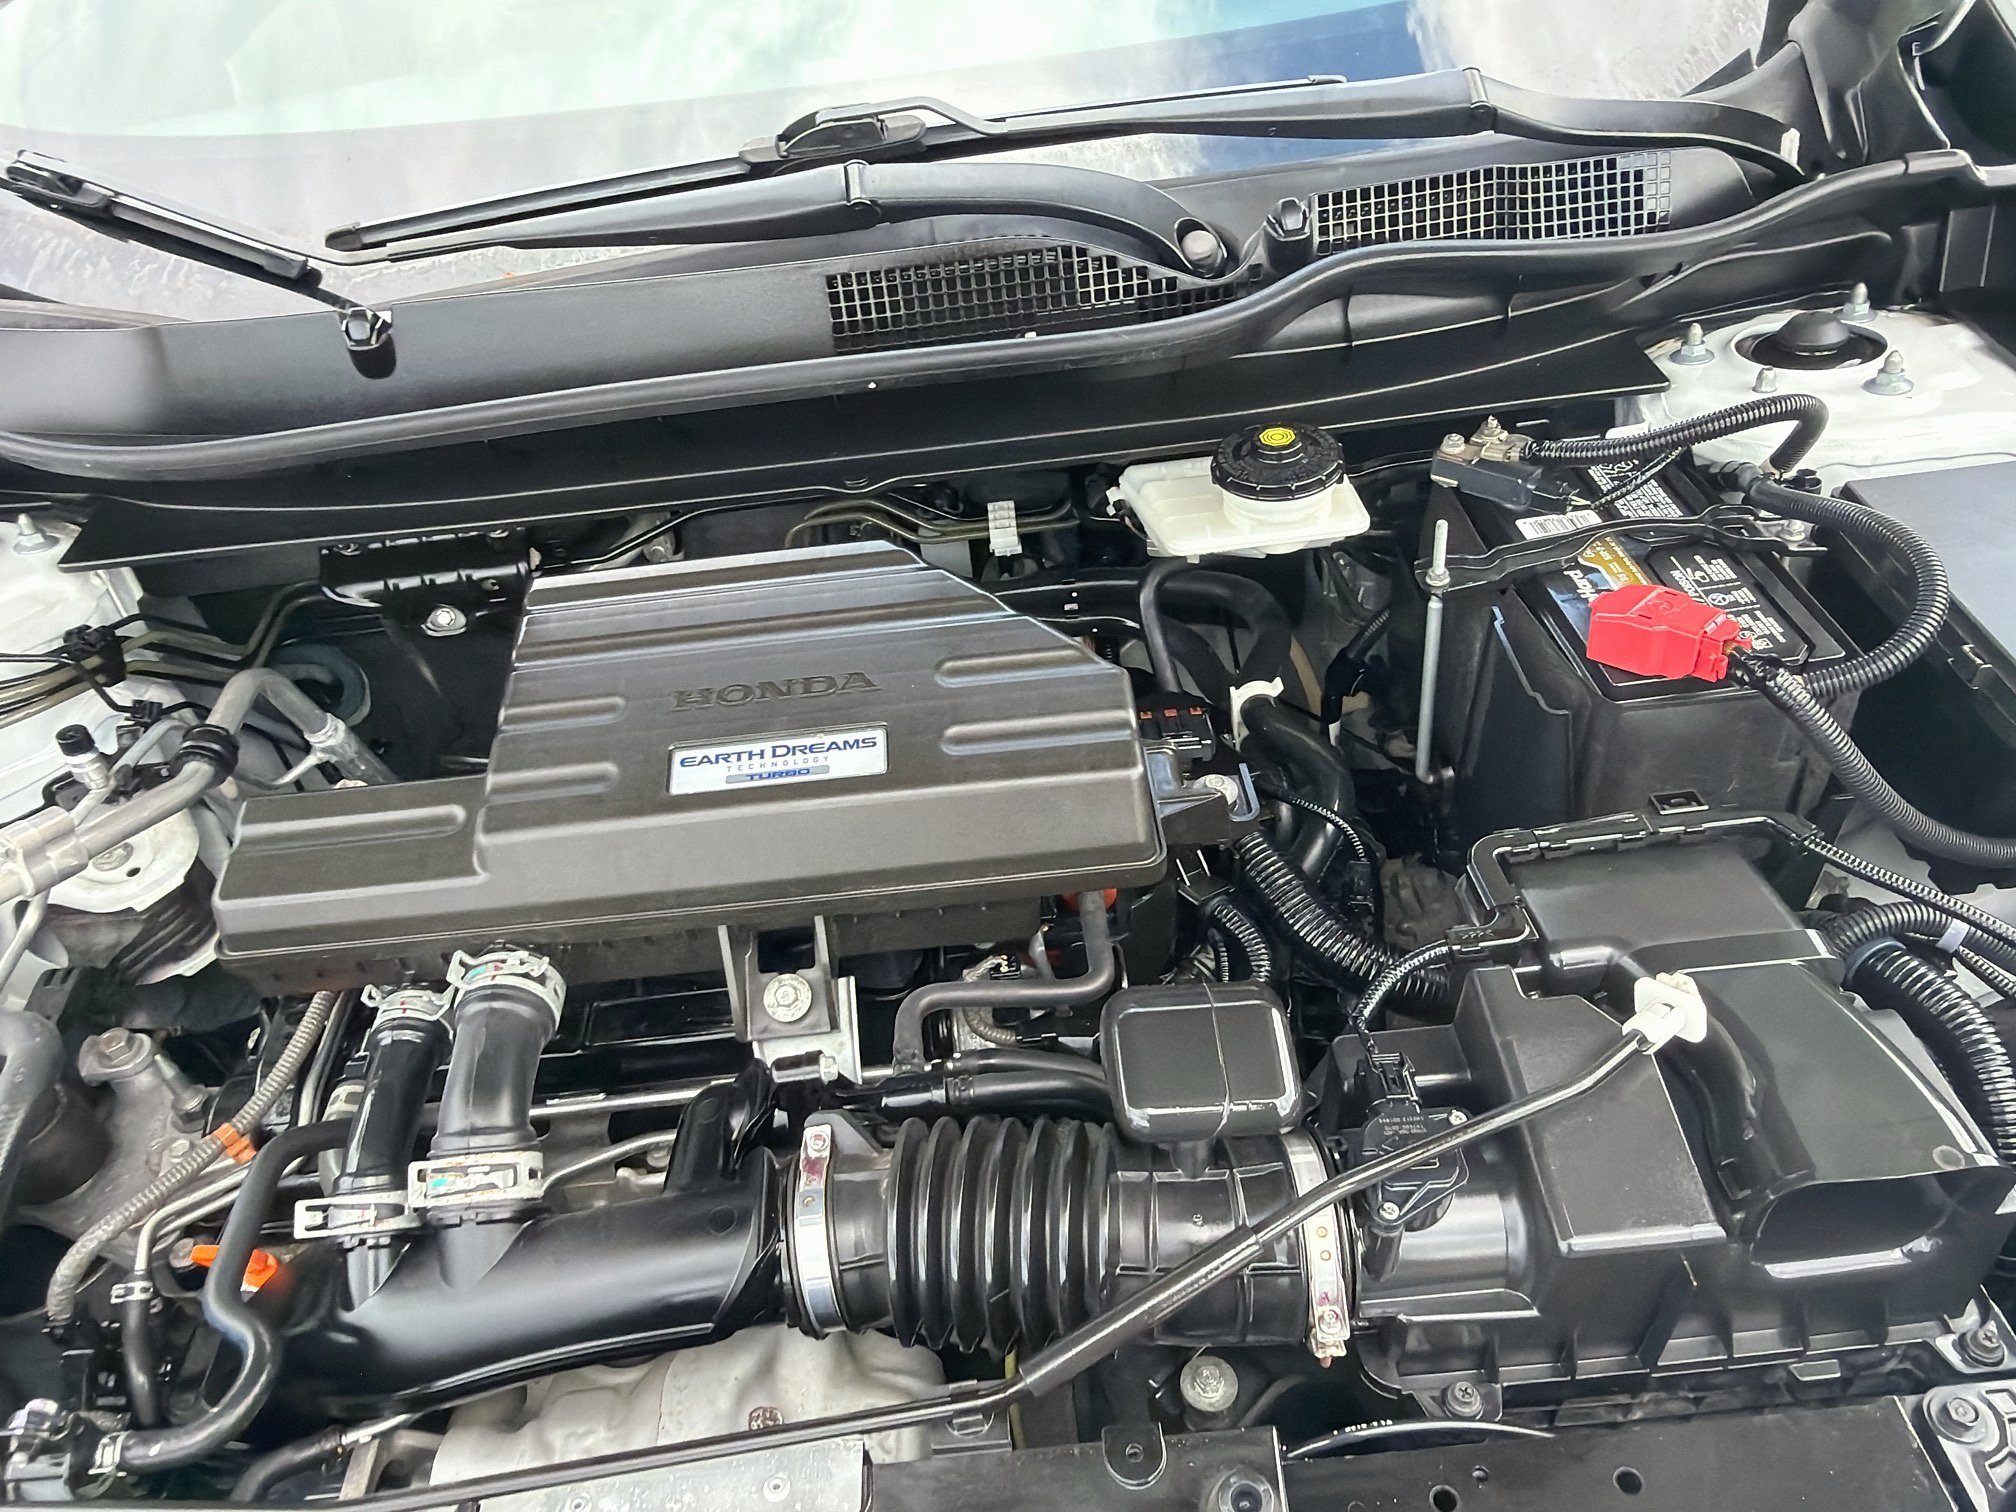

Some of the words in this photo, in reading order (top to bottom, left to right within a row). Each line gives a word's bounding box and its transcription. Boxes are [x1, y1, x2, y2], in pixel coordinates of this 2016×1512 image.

[1670, 569, 1700, 597] POISON
[671, 671, 881, 711] HONDA
[679, 748, 765, 768] EARTH
[726, 755, 830, 772] TECHNOLOGY
[745, 767, 811, 781] TURBO
